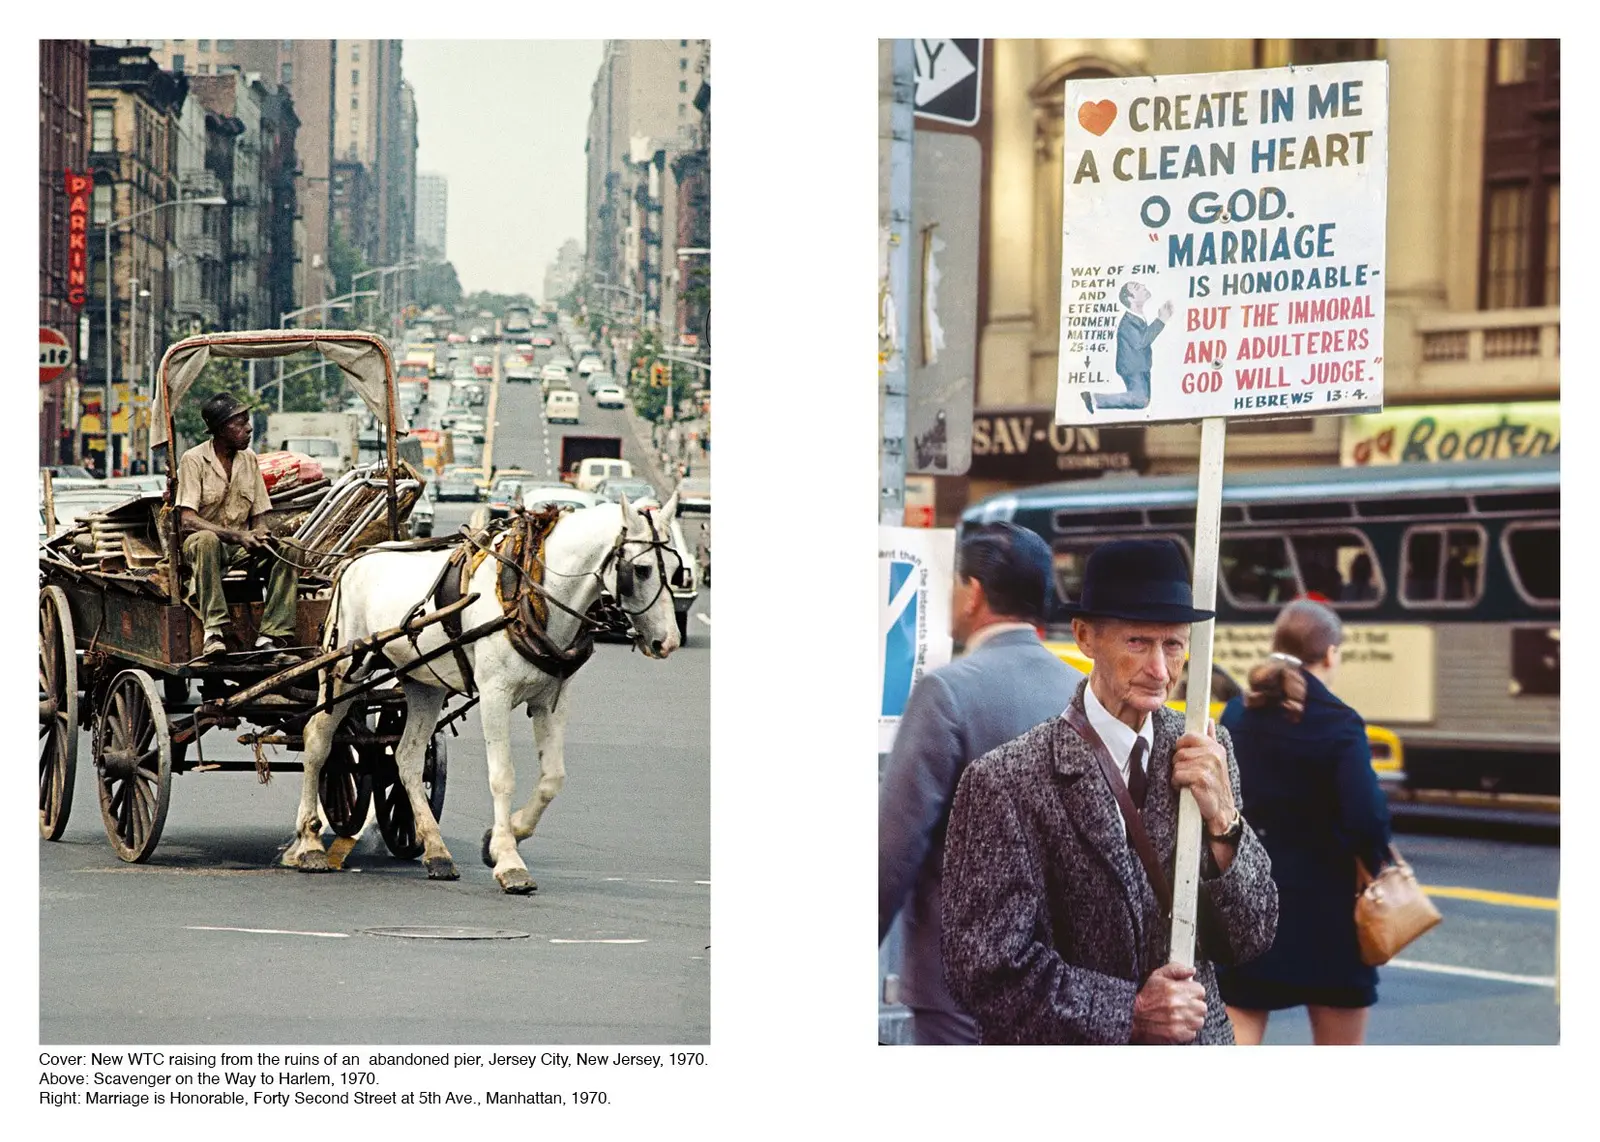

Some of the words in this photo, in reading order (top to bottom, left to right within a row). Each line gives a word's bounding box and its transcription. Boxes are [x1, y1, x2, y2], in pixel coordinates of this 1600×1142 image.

[1128, 91, 1248, 133] CREATE
[1260, 86, 1294, 124] IN
[1308, 80, 1363, 120] ME
[1073, 149, 1101, 184] A
[1112, 141, 1236, 182] CLEAN
[1251, 130, 1373, 174] HEART
[1140, 195, 1171, 228] O
[1188, 186, 1295, 224] GOD.
[69, 178, 87, 304] PARKING
[1071, 266, 1101, 277] WAY
[1107, 266, 1124, 276] OF
[1131, 264, 1160, 275] SIN.
[1071, 279, 1116, 289] DEATH
[1188, 275, 1210, 298] IS
[1079, 291, 1106, 301] AND
[1068, 303, 1120, 314] ETERNAL
[1187, 306, 1232, 332] BUT
[1241, 303, 1279, 328] THE
[1288, 295, 1376, 325] IMMORAL
[1067, 330, 1115, 341] MATTHEW
[1183, 339, 1228, 364] AND
[1236, 328, 1370, 361] ADULTERERS
[1068, 372, 1110, 384] HELL.
[1181, 371, 1223, 395] GOD
[1235, 366, 1291, 391] WILL
[1234, 391, 1314, 409] HEBREWS
[919, 567, 928, 587] the
